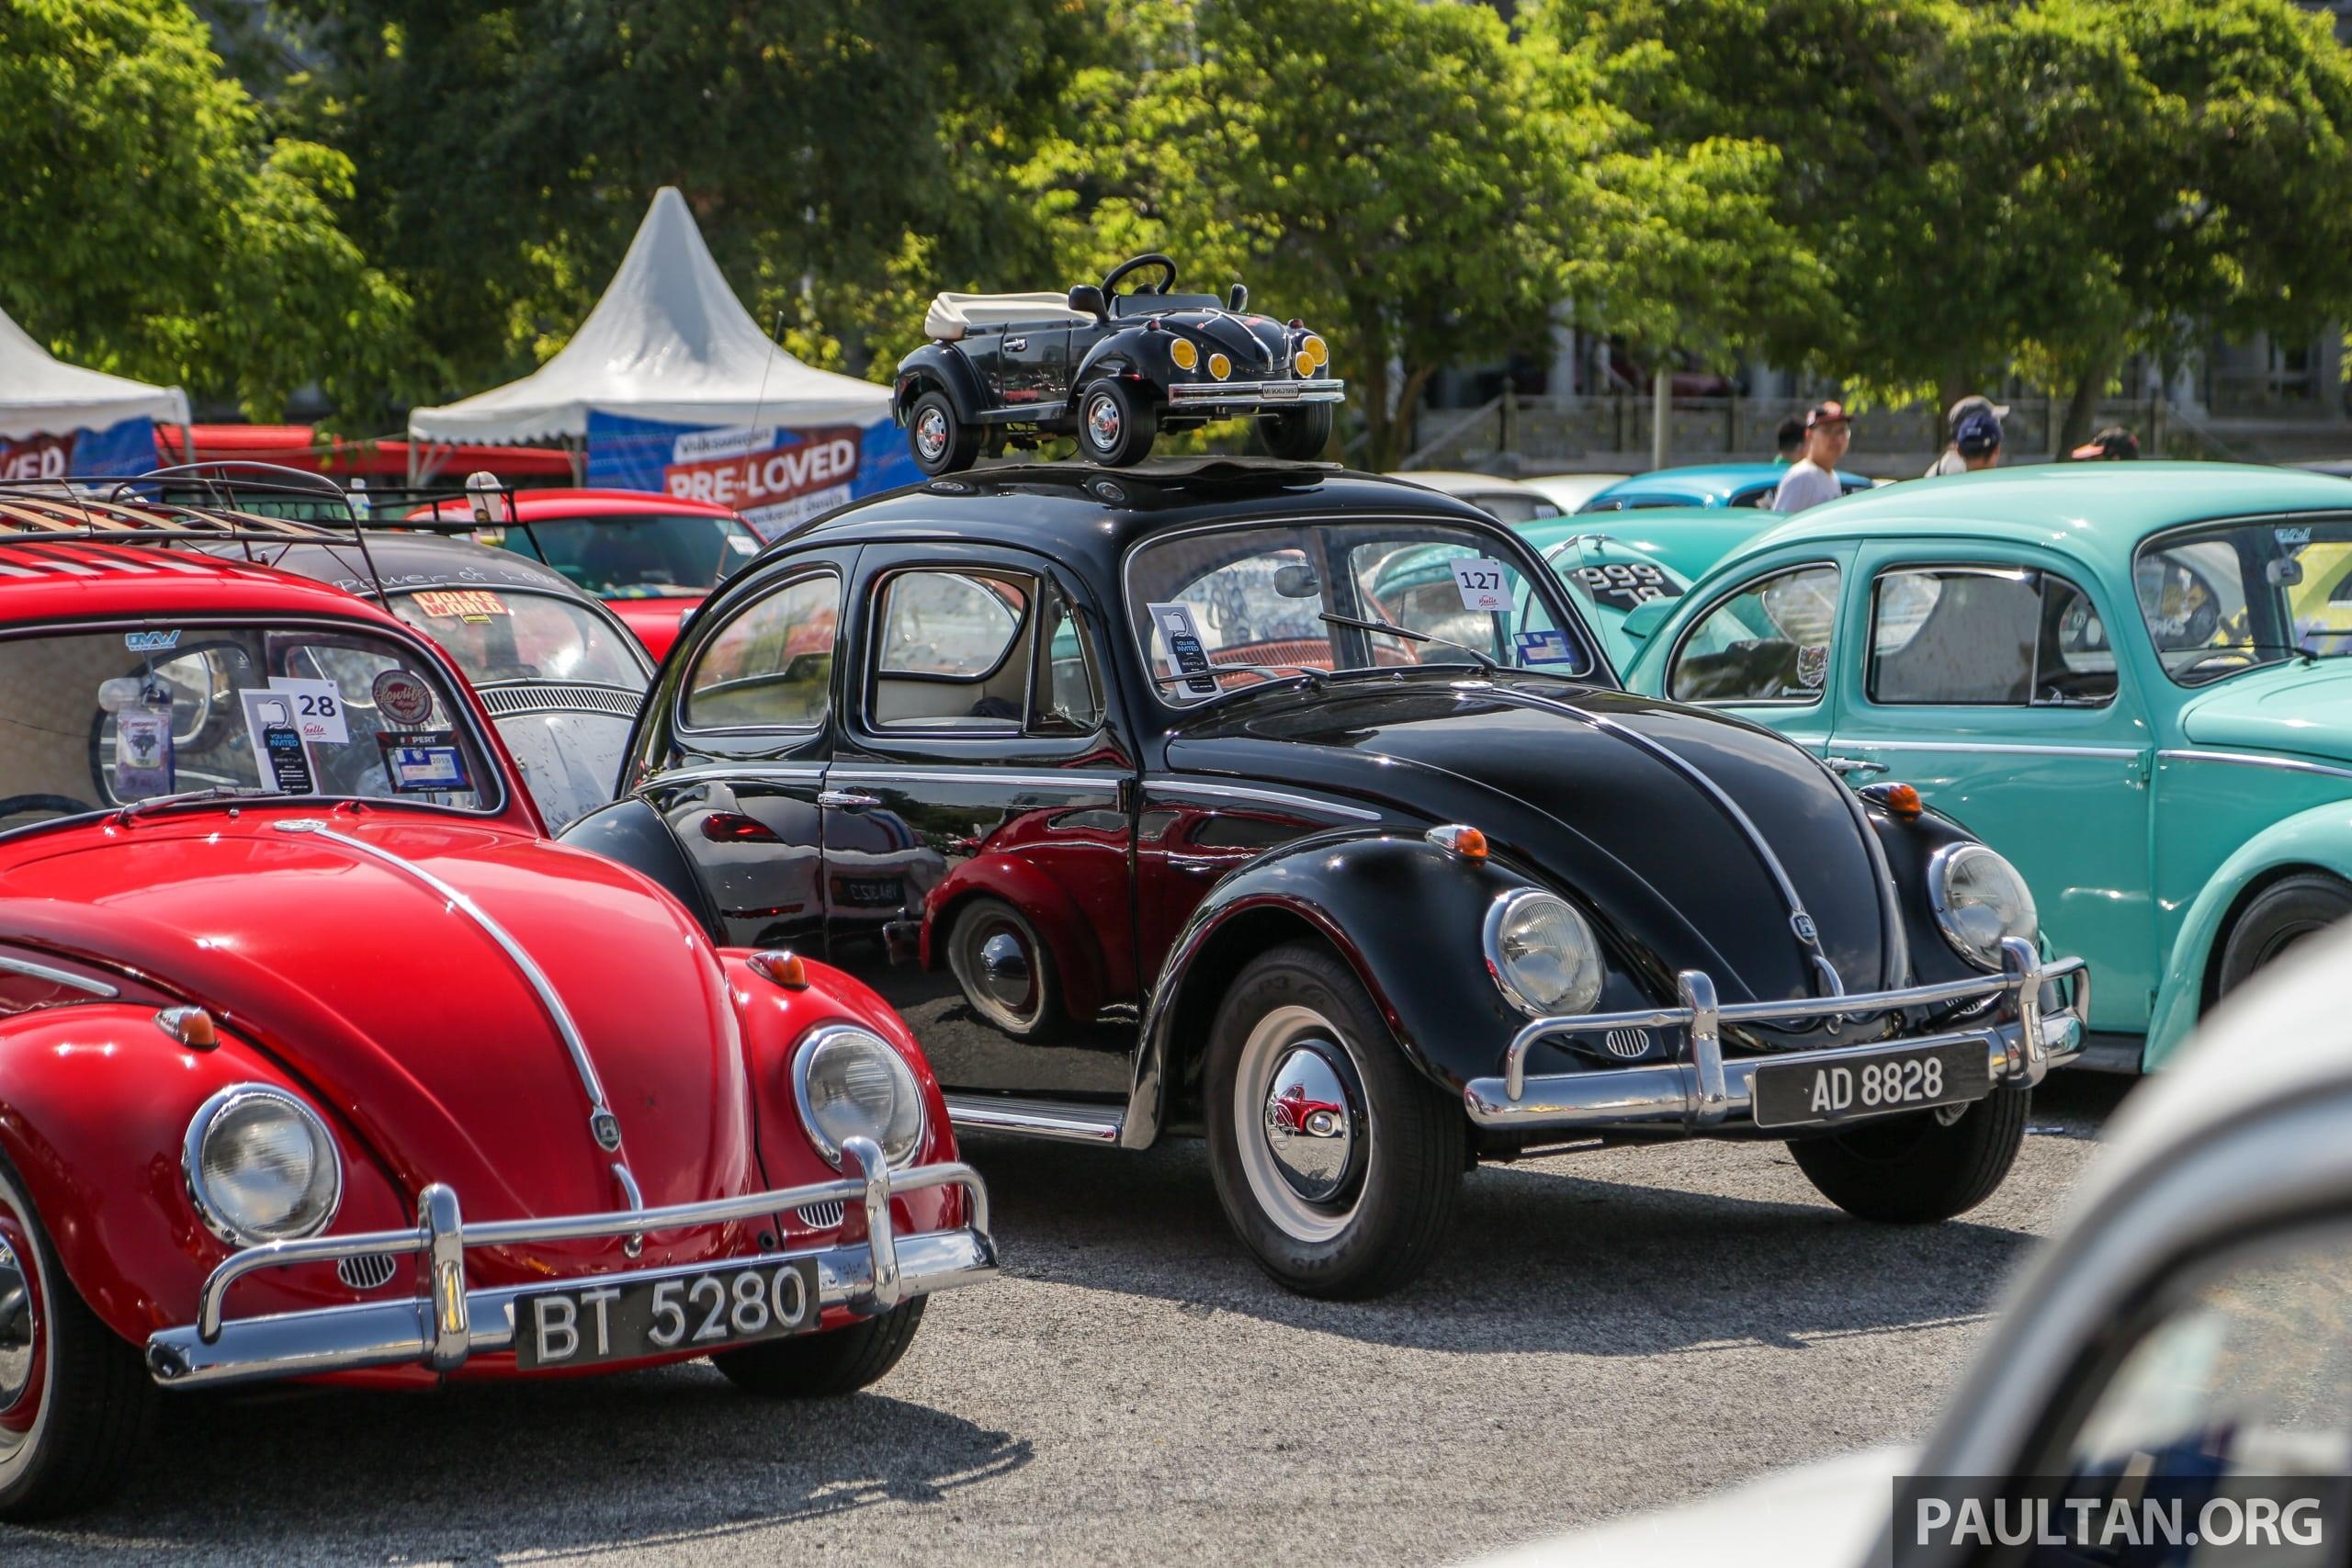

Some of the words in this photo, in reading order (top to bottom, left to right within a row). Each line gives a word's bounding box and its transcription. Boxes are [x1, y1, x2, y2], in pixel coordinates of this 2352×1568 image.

[669, 439, 855, 502] PRE-LOVED
[1460, 571, 1499, 590] 127
[424, 602, 507, 616] WORLD
[299, 695, 336, 717] 28
[1811, 1068, 1852, 1111] AD
[1861, 1057, 1943, 1106] 8828
[534, 1288, 620, 1364] BT
[648, 1266, 806, 1347] 5280
